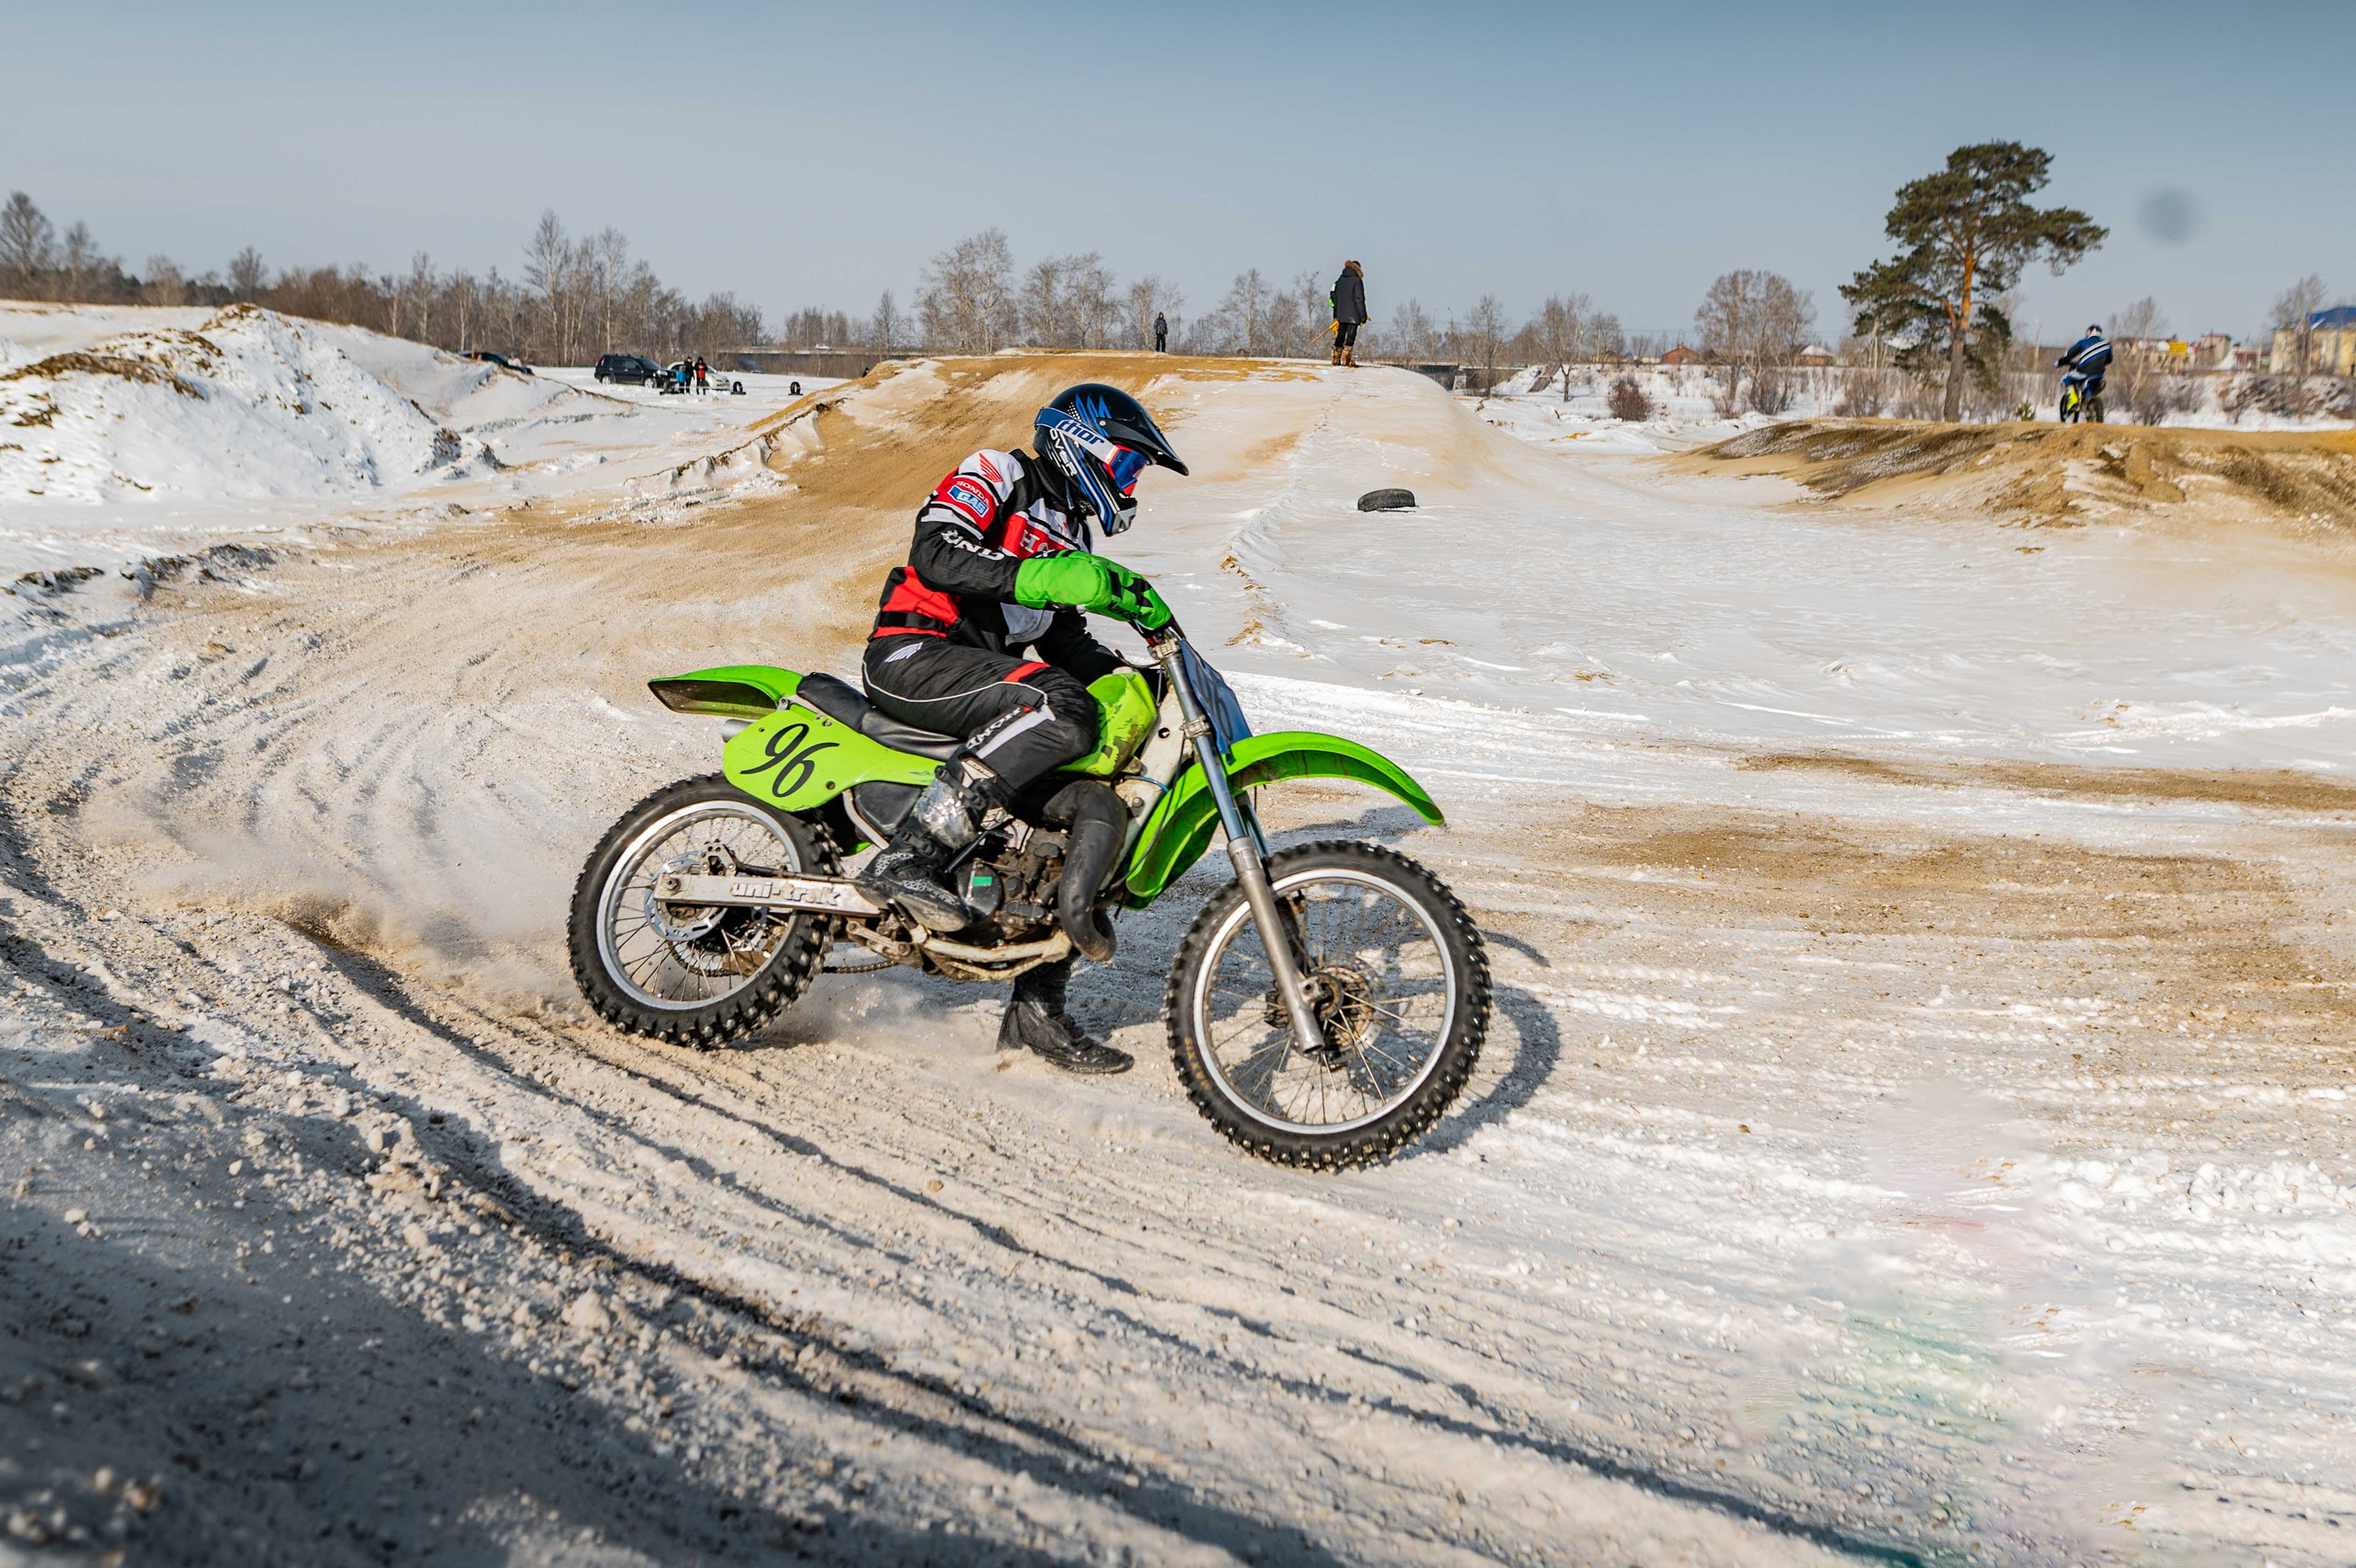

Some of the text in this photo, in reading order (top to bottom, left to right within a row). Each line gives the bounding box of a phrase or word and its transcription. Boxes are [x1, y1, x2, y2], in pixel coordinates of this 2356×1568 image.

[1057, 419, 1105, 445] thor
[956, 490, 987, 516] GAS
[957, 480, 990, 506] HONDA
[739, 722, 841, 799] 96
[730, 881, 841, 906] uni-trak
